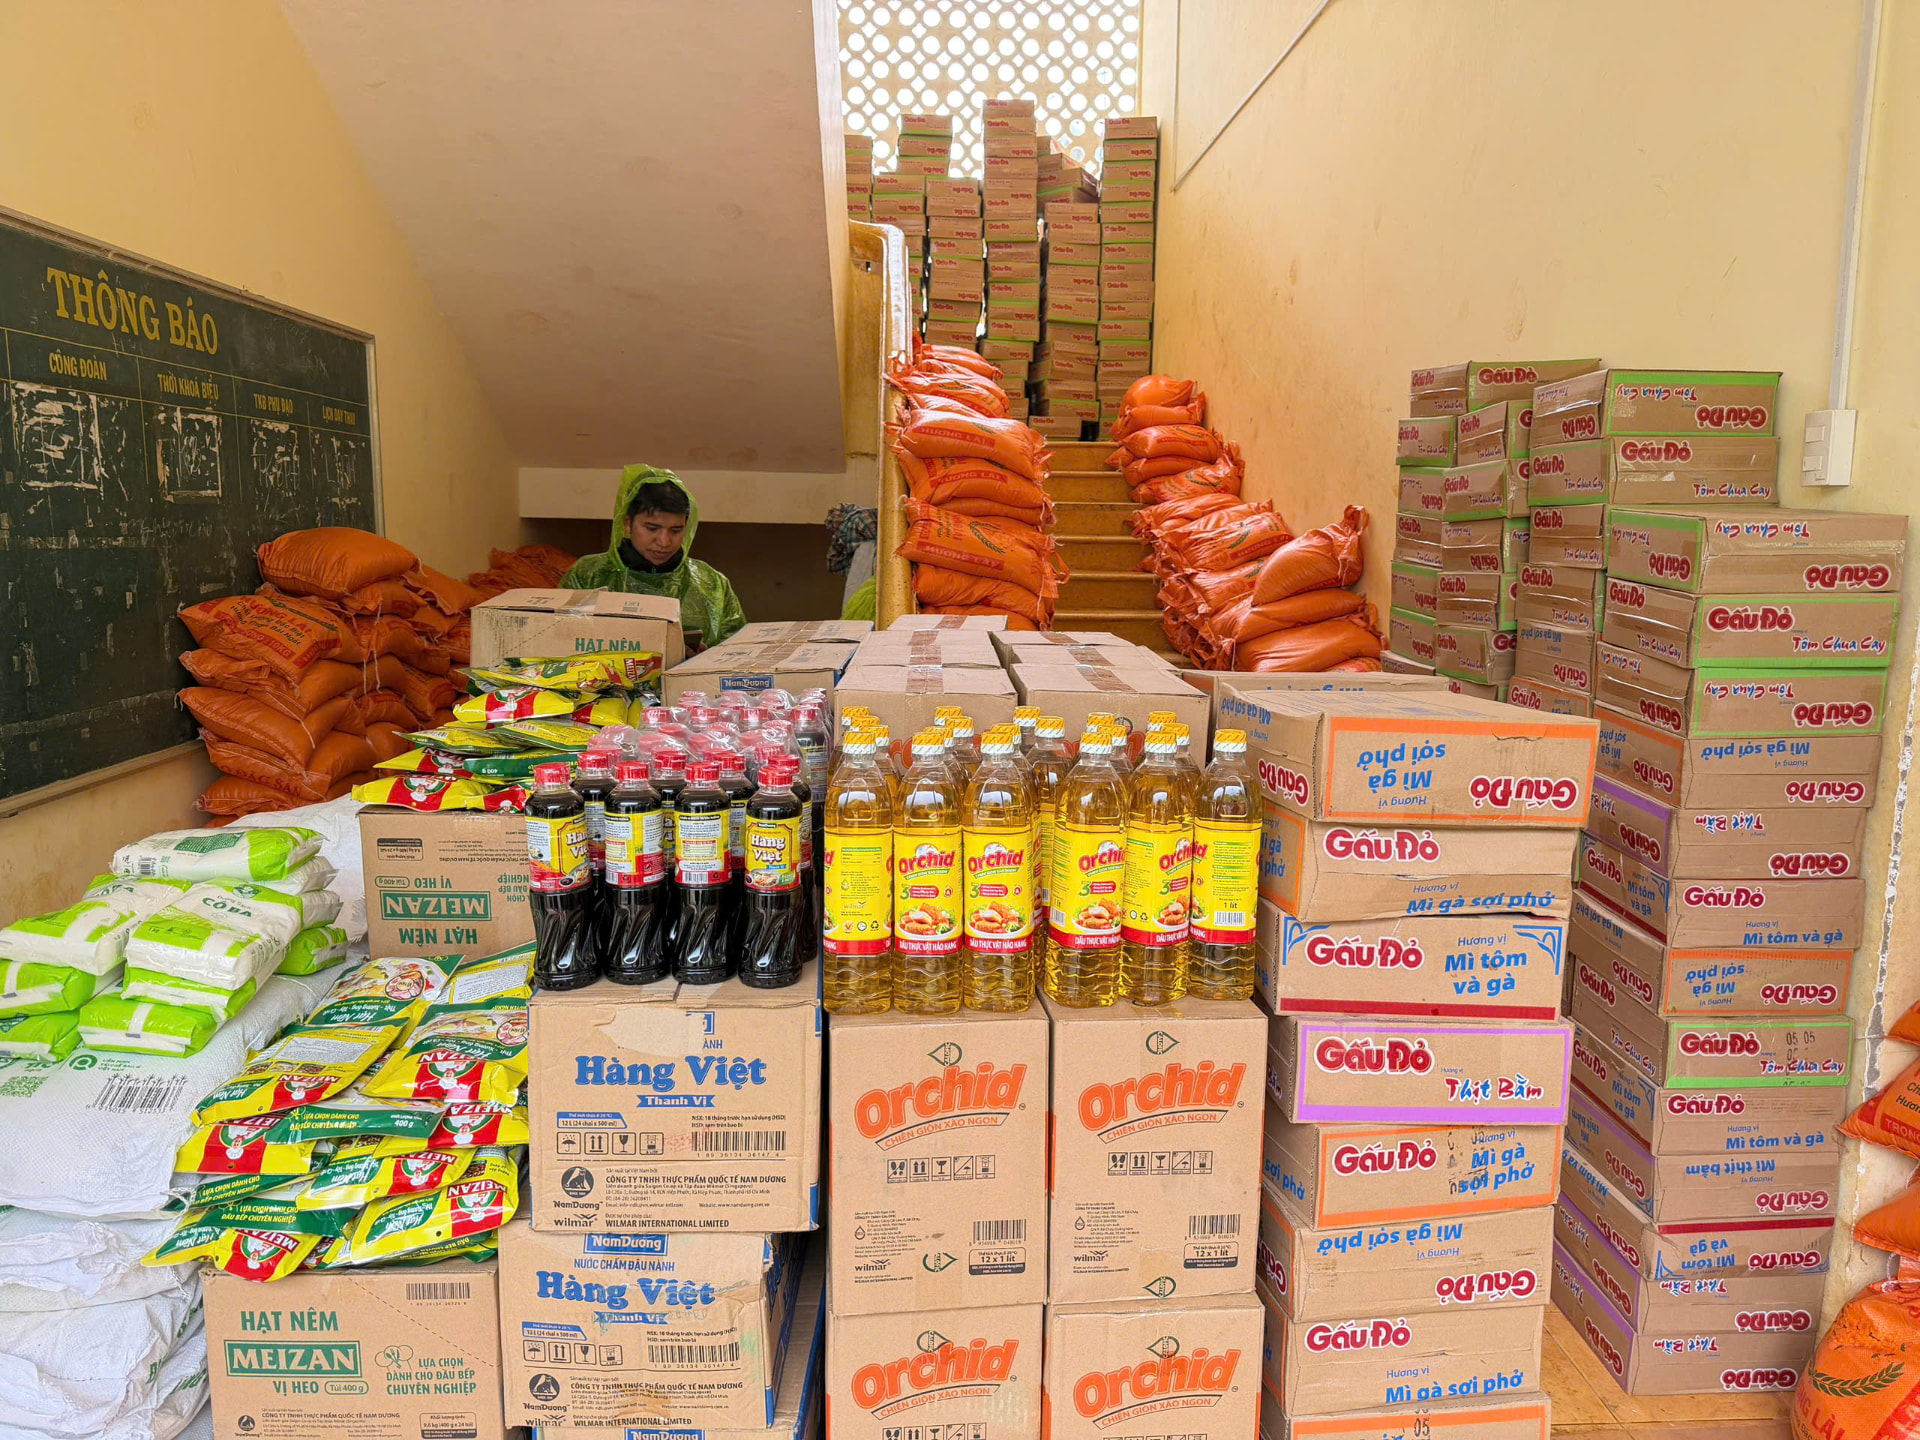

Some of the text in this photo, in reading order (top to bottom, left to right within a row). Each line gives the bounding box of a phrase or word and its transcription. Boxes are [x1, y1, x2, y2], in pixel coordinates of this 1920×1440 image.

[47, 267, 218, 355] THÔNG BÁO
[49, 348, 107, 381] CÔNG ĐOÀN
[1693, 483, 1771, 499] Tôm Chua Cay
[1356, 740, 1446, 772] sợi phở
[1701, 741, 1810, 762] Mì gà sợi phở
[1367, 769, 1432, 794] Mì gà
[1413, 881, 1459, 893] Hương vị
[386, 897, 485, 915] MEIZAN
[1406, 892, 1555, 914] Mì gà sợi phở
[399, 927, 477, 947] HẠT NÊM
[1457, 934, 1507, 948] Hương vị
[1743, 931, 1843, 945] Mì tôm và gà
[1445, 950, 1527, 972] Mì tôm
[1453, 975, 1516, 997] và gà
[574, 1055, 767, 1092] Hàng Việt
[1443, 1073, 1544, 1105] Thịt Bằm
[645, 1096, 708, 1107] Thanh Vị
[885, 1116, 998, 1148] CHIÊN GIÒN XÀO NGON
[606, 1174, 627, 1183] CÔNG
[661, 1176, 682, 1184] THỰC
[684, 1174, 706, 1183] PHẨM
[708, 1174, 727, 1183] QUỐC
[729, 1174, 738, 1183] TẾ
[759, 1175, 786, 1183] DƯƠNG
[448, 1180, 507, 1199] MEIZAN
[606, 1219, 729, 1228] WILMAR INTERNATIONAL LIMITED
[574, 1258, 675, 1272] NƯỚC CHẤM ĐẬU NÀNH
[855, 1262, 887, 1272] wilmar
[536, 1271, 715, 1310] Hàng Việt
[241, 1307, 338, 1335] HẠT NÊM
[232, 1348, 355, 1371] MEIZAN
[419, 1357, 464, 1370] LỰA CHỌN
[387, 1368, 475, 1381] DÀNH CHO ĐẦU BẾP
[274, 1382, 320, 1396] VỊ HEO
[329, 1383, 364, 1394] Túi 400 g
[387, 1381, 476, 1396] CHUYÊN NGHIỆP
[1385, 1369, 1525, 1404] Mì gà sợi phở
